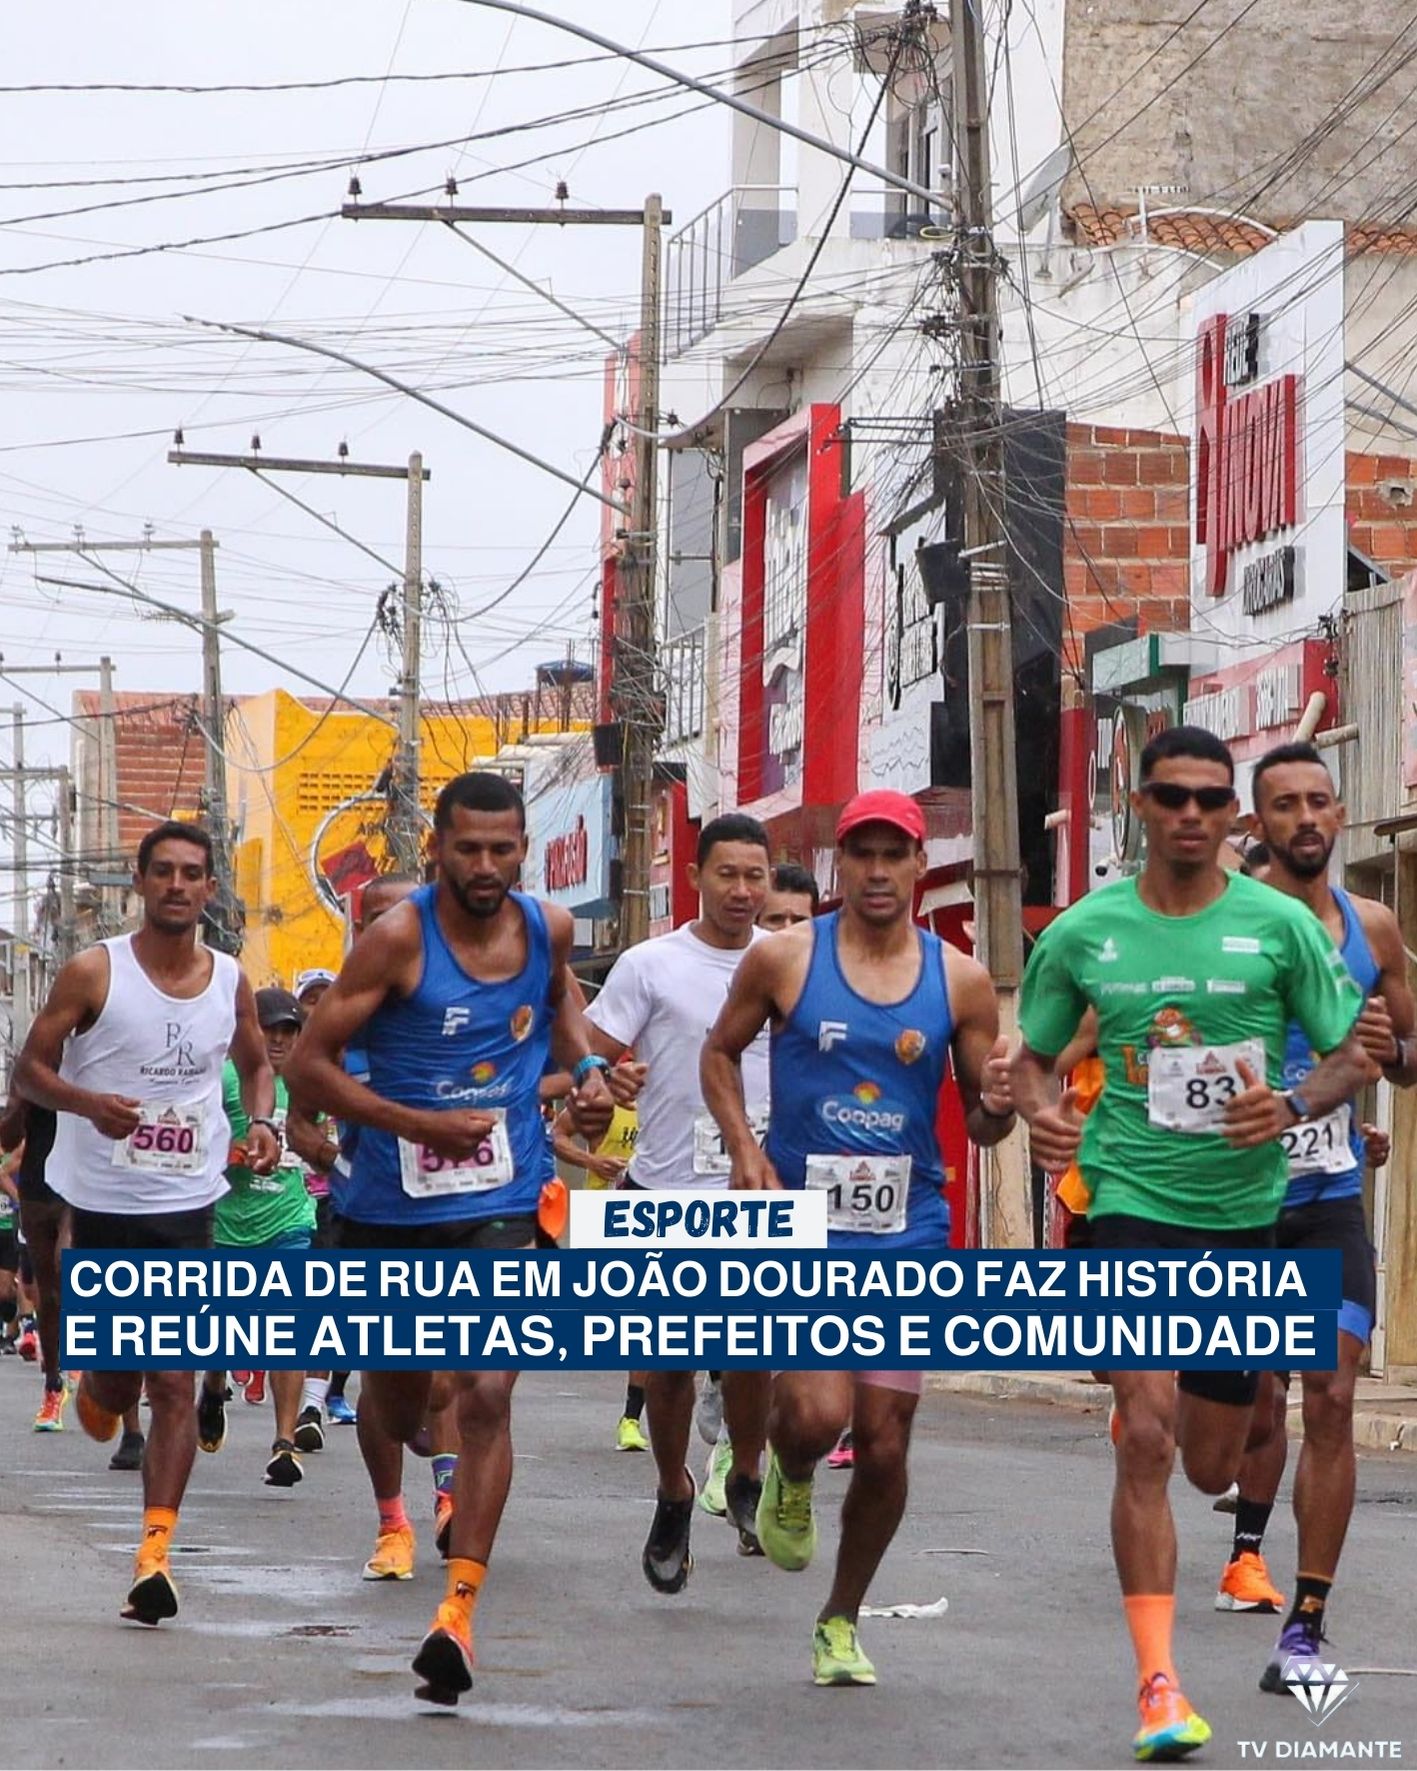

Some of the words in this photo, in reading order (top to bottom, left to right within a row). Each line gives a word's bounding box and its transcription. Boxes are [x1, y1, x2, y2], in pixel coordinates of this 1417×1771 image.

[1186, 1076, 1237, 1109] 83
[822, 1101, 905, 1133] Coopag
[134, 1124, 194, 1154] 560
[421, 1137, 494, 1172] 56
[1280, 1121, 1333, 1159] 221
[827, 1183, 894, 1213] 150
